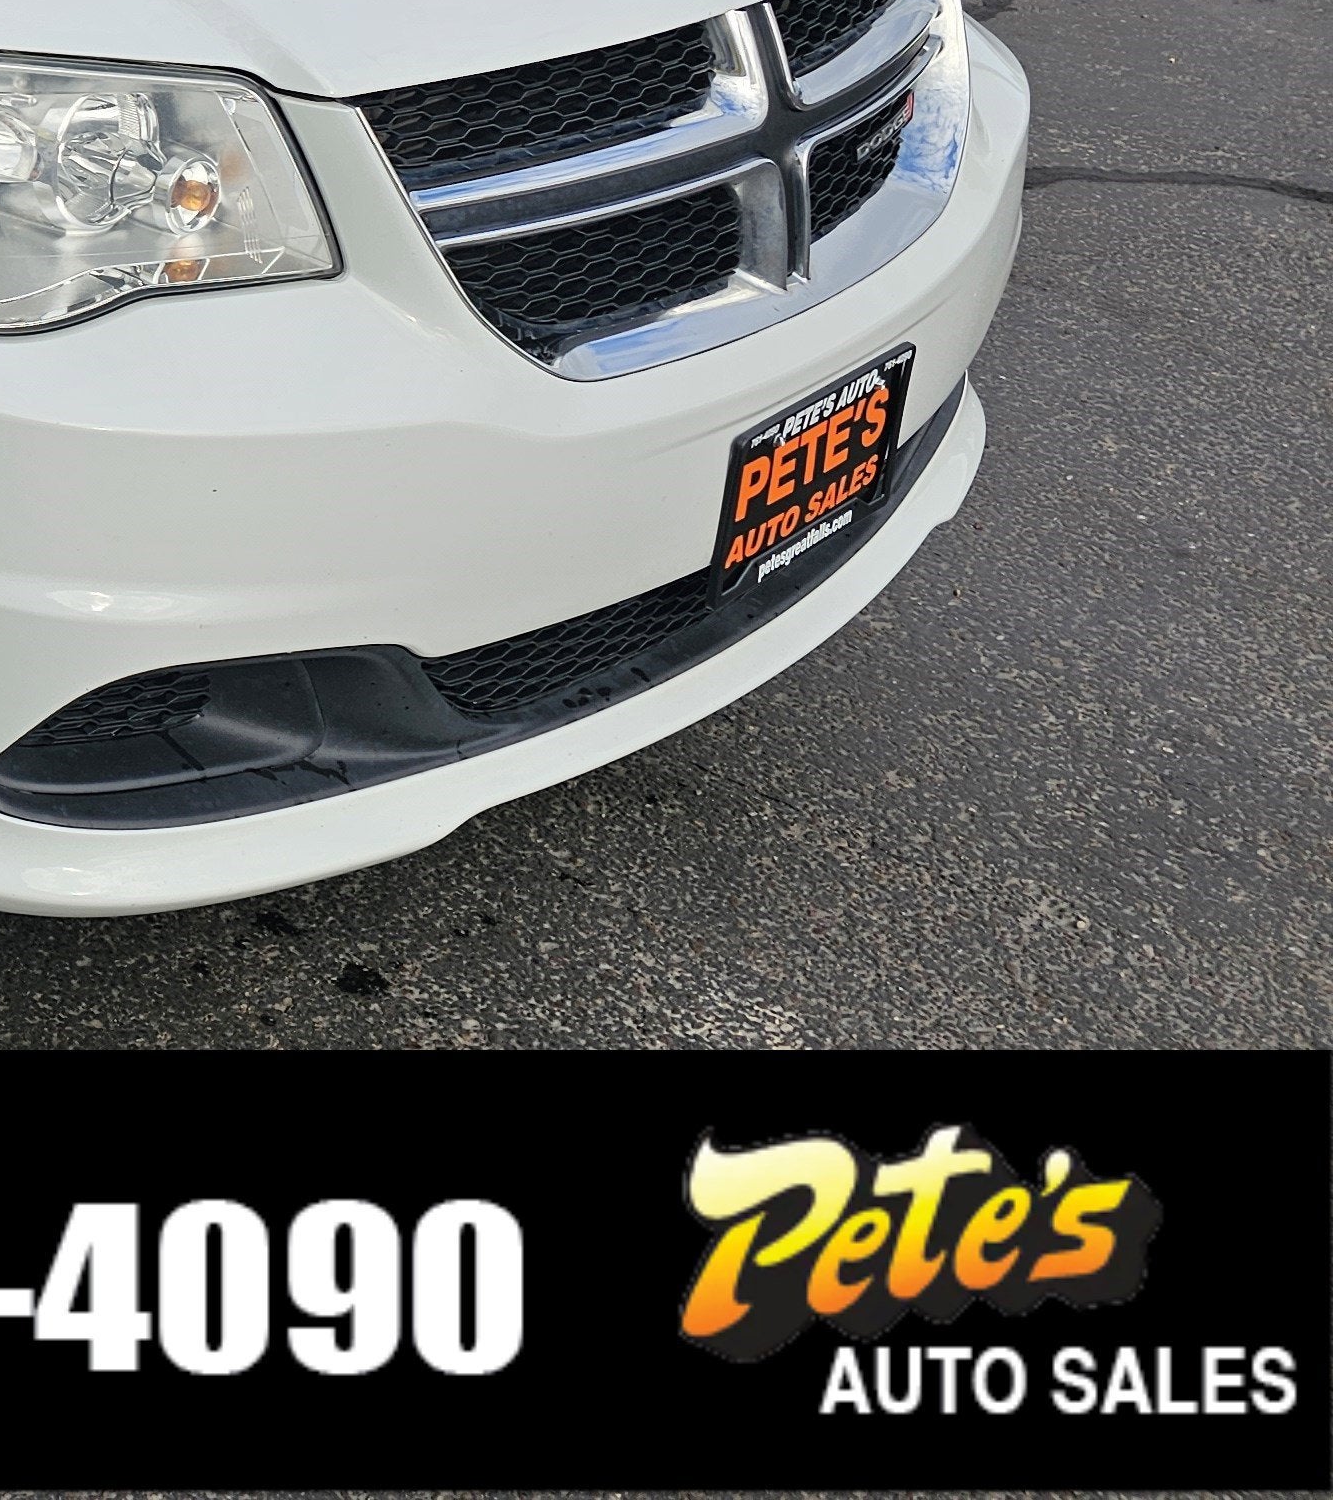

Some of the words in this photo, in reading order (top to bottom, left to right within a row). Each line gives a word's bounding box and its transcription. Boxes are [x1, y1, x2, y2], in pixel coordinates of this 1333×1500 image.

[856, 101, 911, 161] DODGE
[782, 392, 837, 439] PETE'S
[835, 368, 880, 413] AUTO
[735, 387, 890, 523] PETE'S
[725, 505, 801, 569] AUTO
[804, 454, 879, 523] SALES
[757, 509, 853, 583] petesgreatfalls.com
